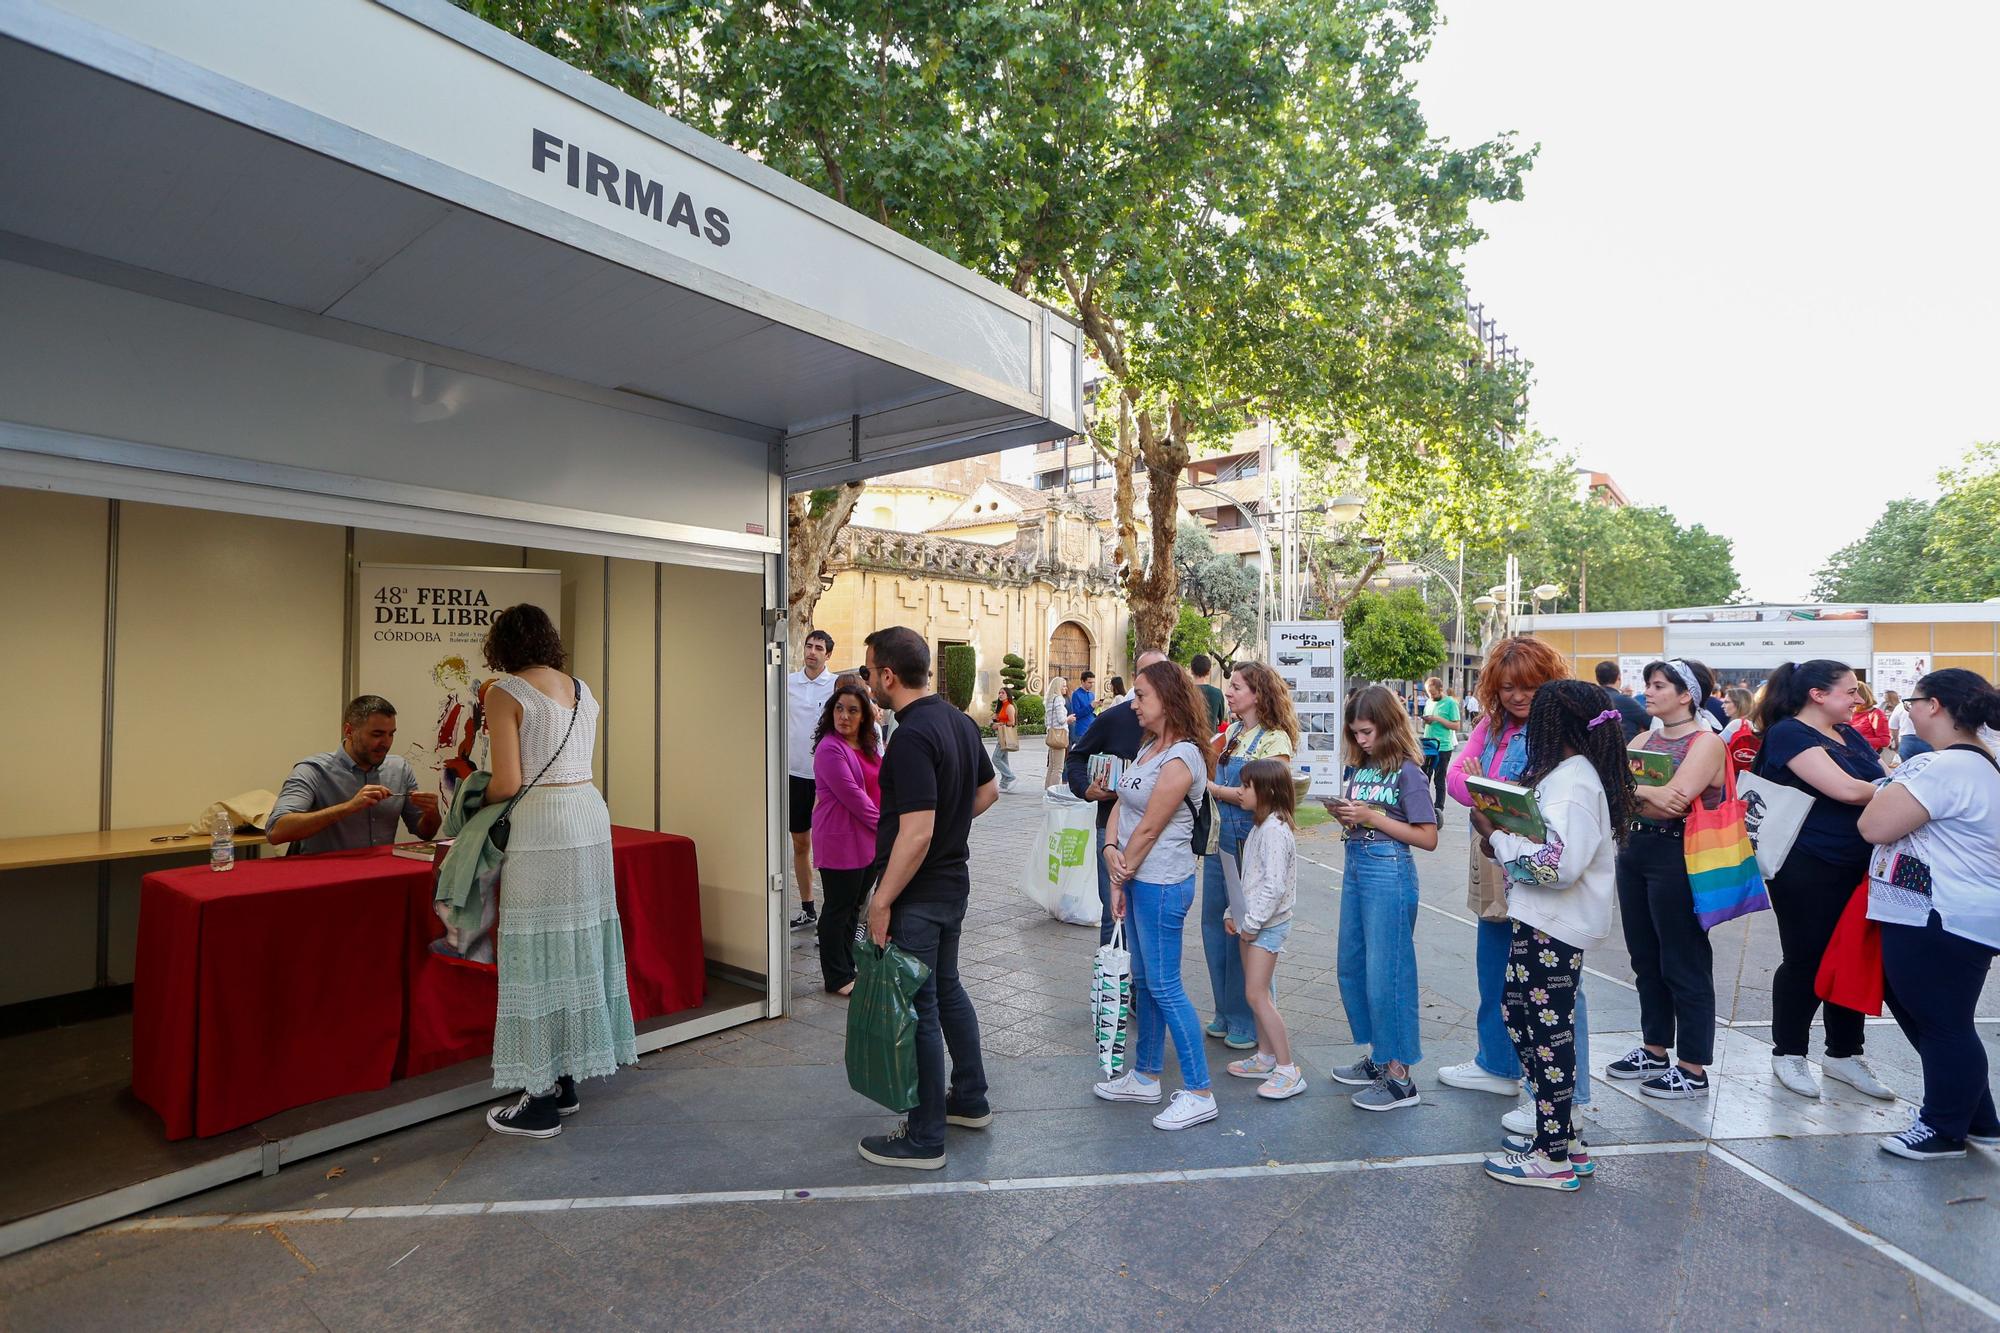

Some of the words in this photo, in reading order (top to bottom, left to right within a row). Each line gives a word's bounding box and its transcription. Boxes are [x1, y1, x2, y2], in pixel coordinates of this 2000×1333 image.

[532, 127, 731, 247] FIRMAS
[417, 587, 490, 606] FERIA
[375, 606, 425, 625] DEL
[374, 628, 442, 642] CÓRDOBA
[1303, 639, 1335, 648] Papel
